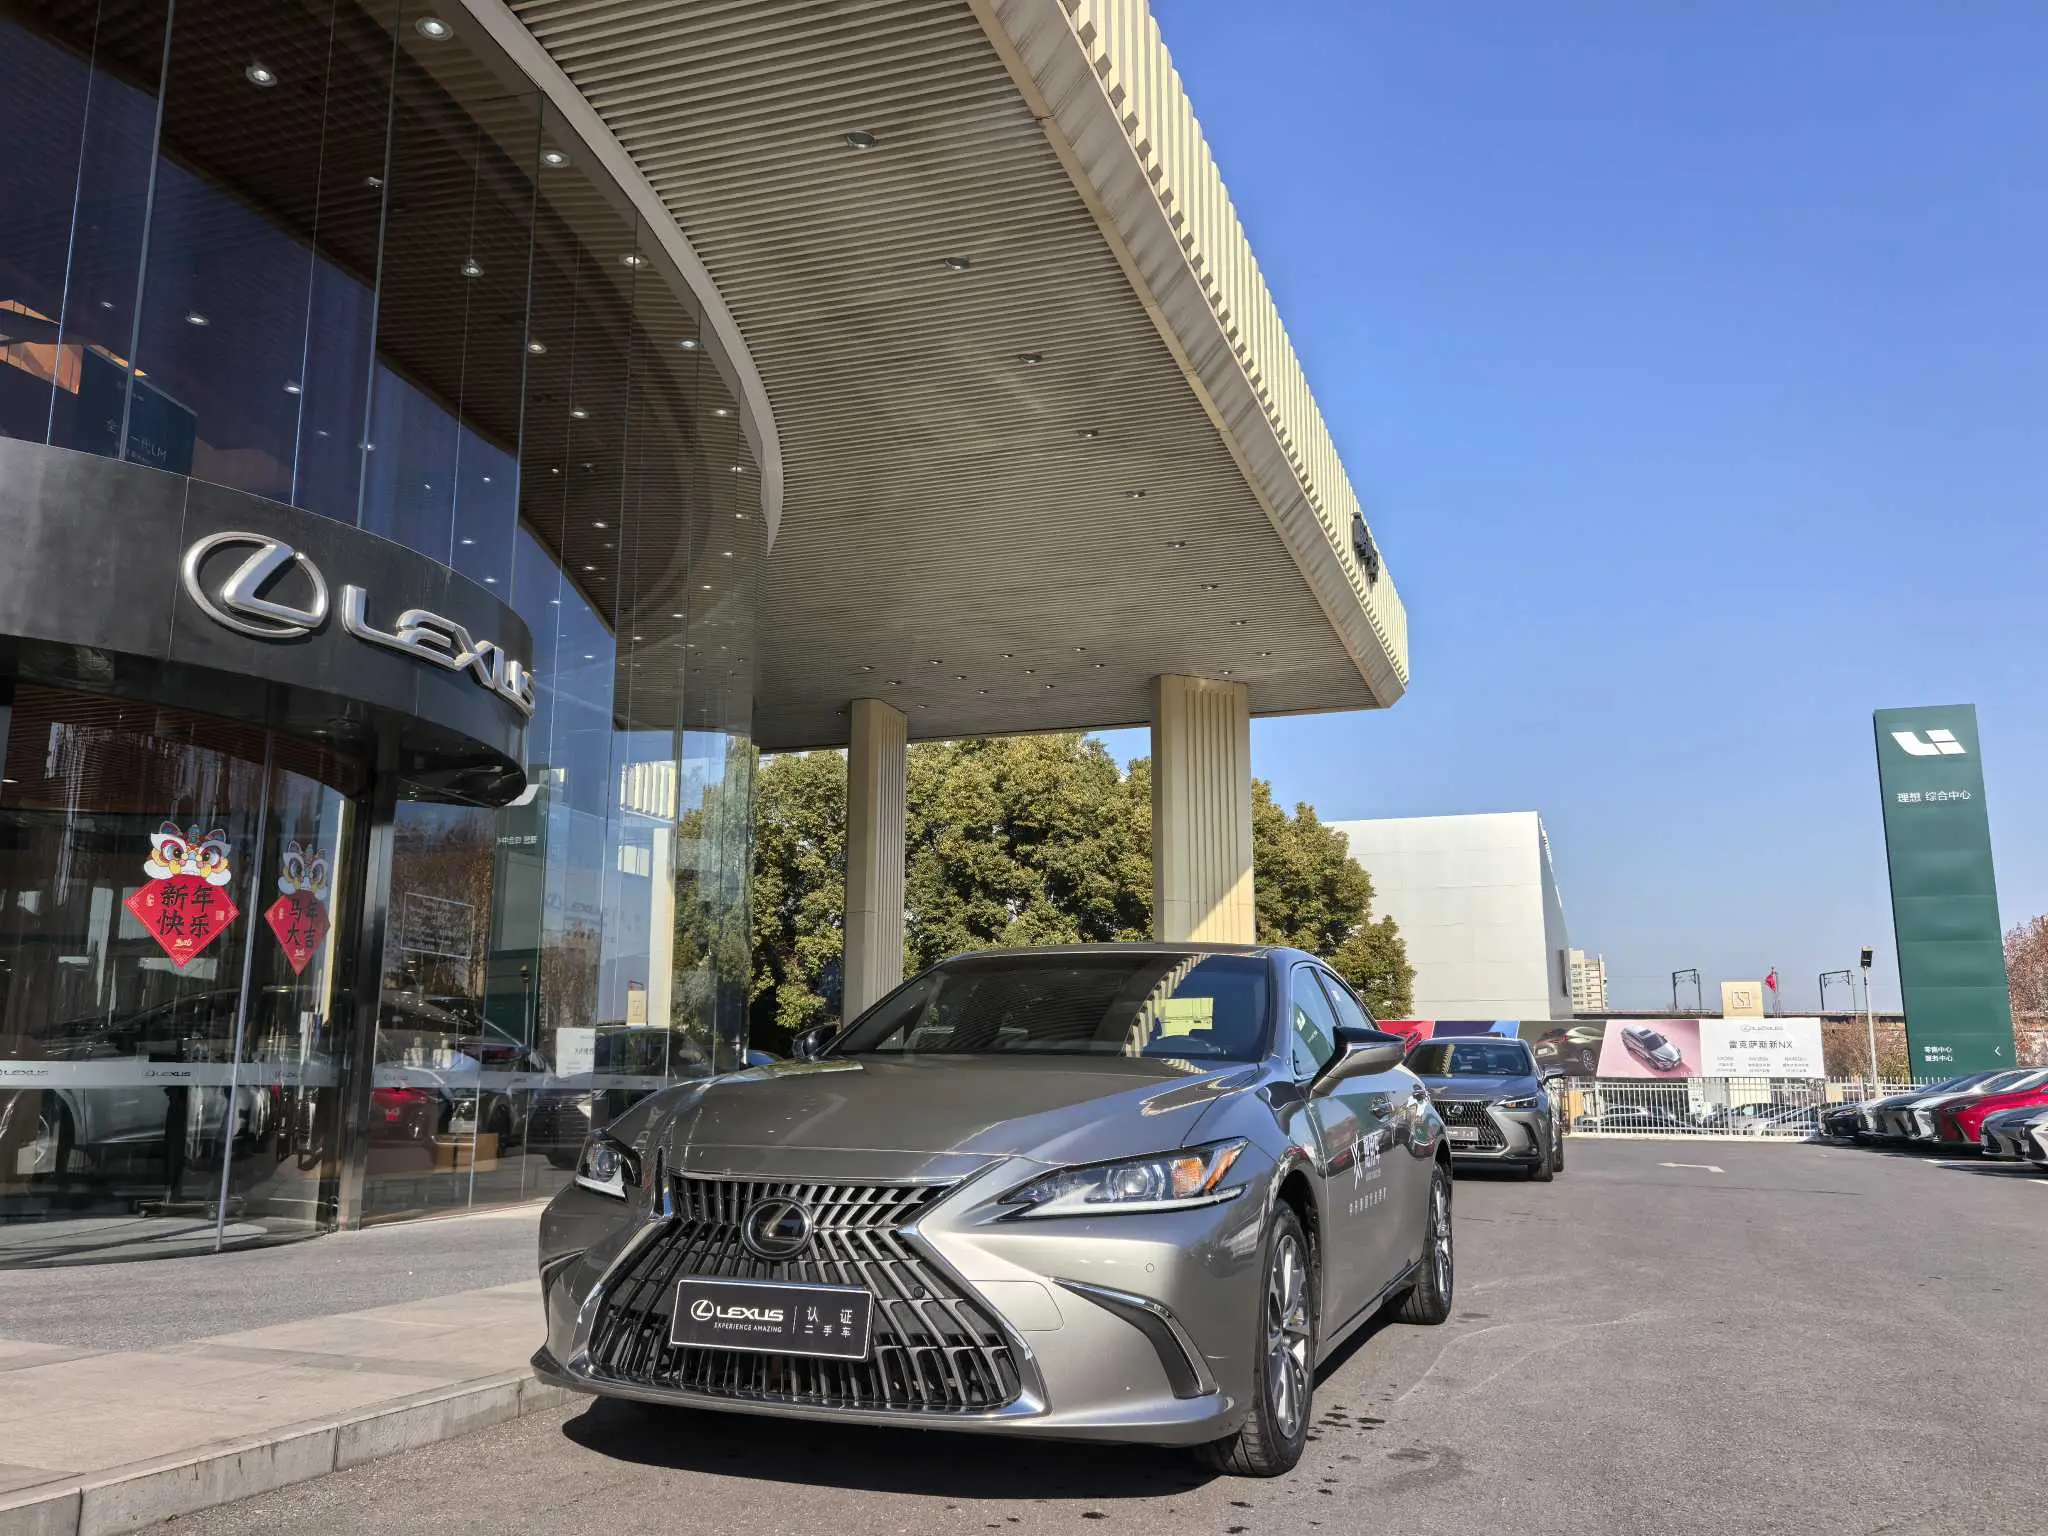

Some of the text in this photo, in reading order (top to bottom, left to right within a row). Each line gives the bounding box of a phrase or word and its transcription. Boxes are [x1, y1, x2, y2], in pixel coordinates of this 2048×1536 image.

[341, 583, 536, 719] LEXUS
[1925, 790, 1971, 801] 综合中心
[160, 882, 214, 912] 新年
[156, 910, 210, 939] 快乐
[286, 922, 317, 948] 大吉
[716, 1305, 784, 1322] LEXUS
[806, 1306, 853, 1324] 认证
[714, 1322, 782, 1333] EXPERIENCE AMAZING
[804, 1324, 851, 1338] 二手车
